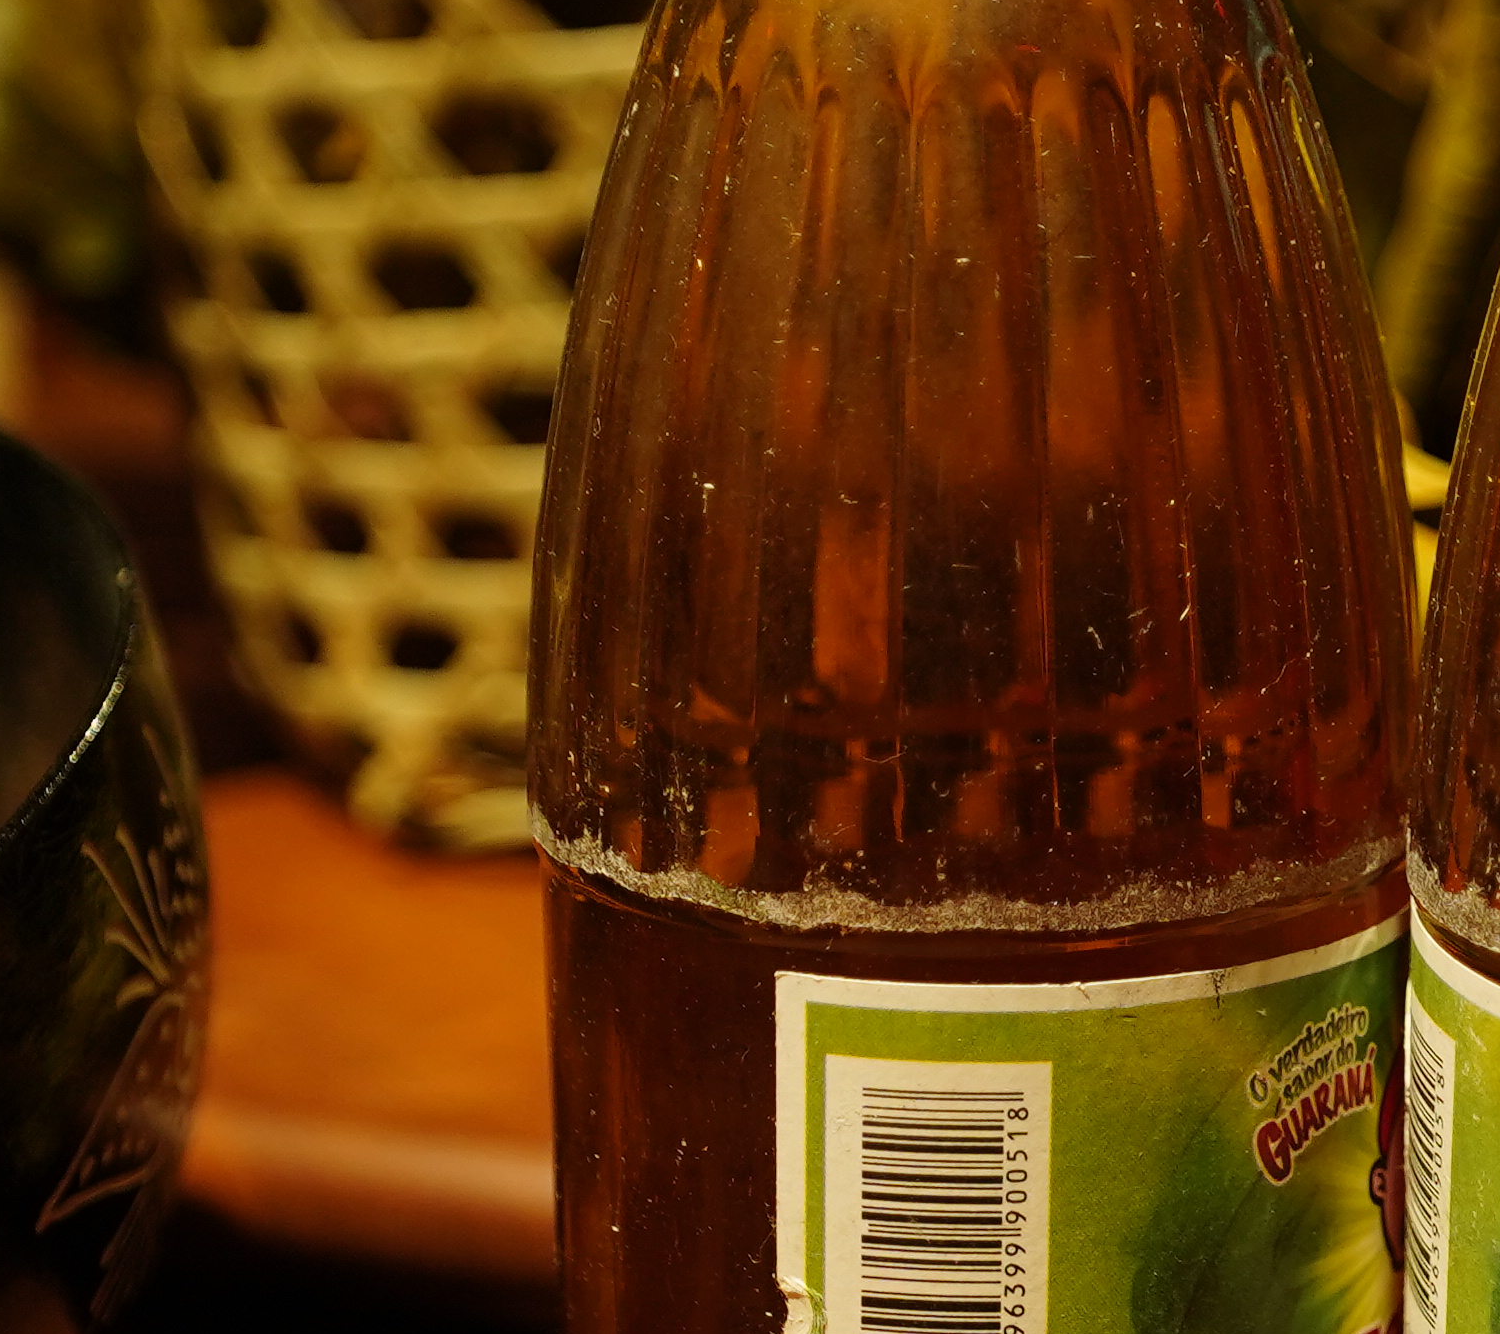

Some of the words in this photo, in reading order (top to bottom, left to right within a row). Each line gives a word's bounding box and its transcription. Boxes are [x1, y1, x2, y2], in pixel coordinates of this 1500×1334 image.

[1250, 1070, 1269, 1103] O
[1268, 1007, 1368, 1083] verdadeiro
[1283, 1050, 1334, 1103] sabor
[1336, 1038, 1356, 1066] do
[1256, 1046, 1376, 1182] GUARANÁ
